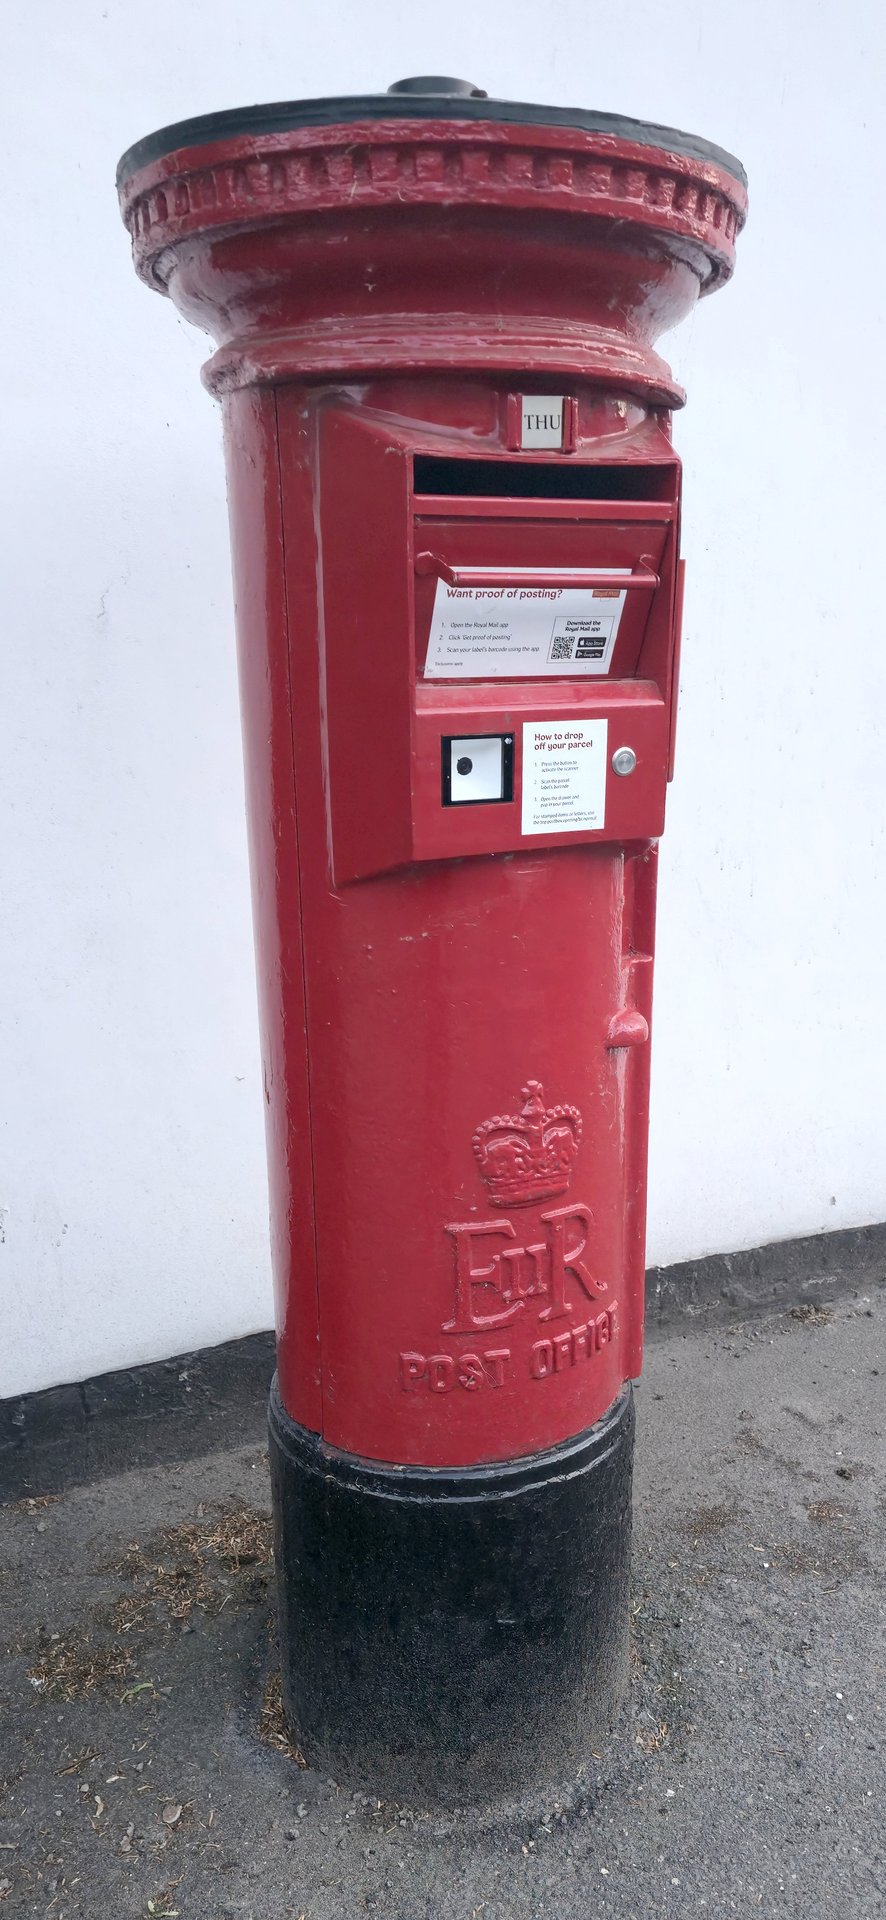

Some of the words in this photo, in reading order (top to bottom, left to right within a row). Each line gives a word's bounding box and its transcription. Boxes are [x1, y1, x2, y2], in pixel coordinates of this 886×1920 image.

[524, 415, 560, 430] THU
[446, 589, 472, 598] Want
[475, 589, 505, 600] proof
[506, 589, 518, 598] of
[520, 589, 562, 600] posting?
[564, 732, 584, 740] drop
[534, 742, 546, 750] off
[568, 740, 593, 750] parcel
[400, 1349, 511, 1392] POST
